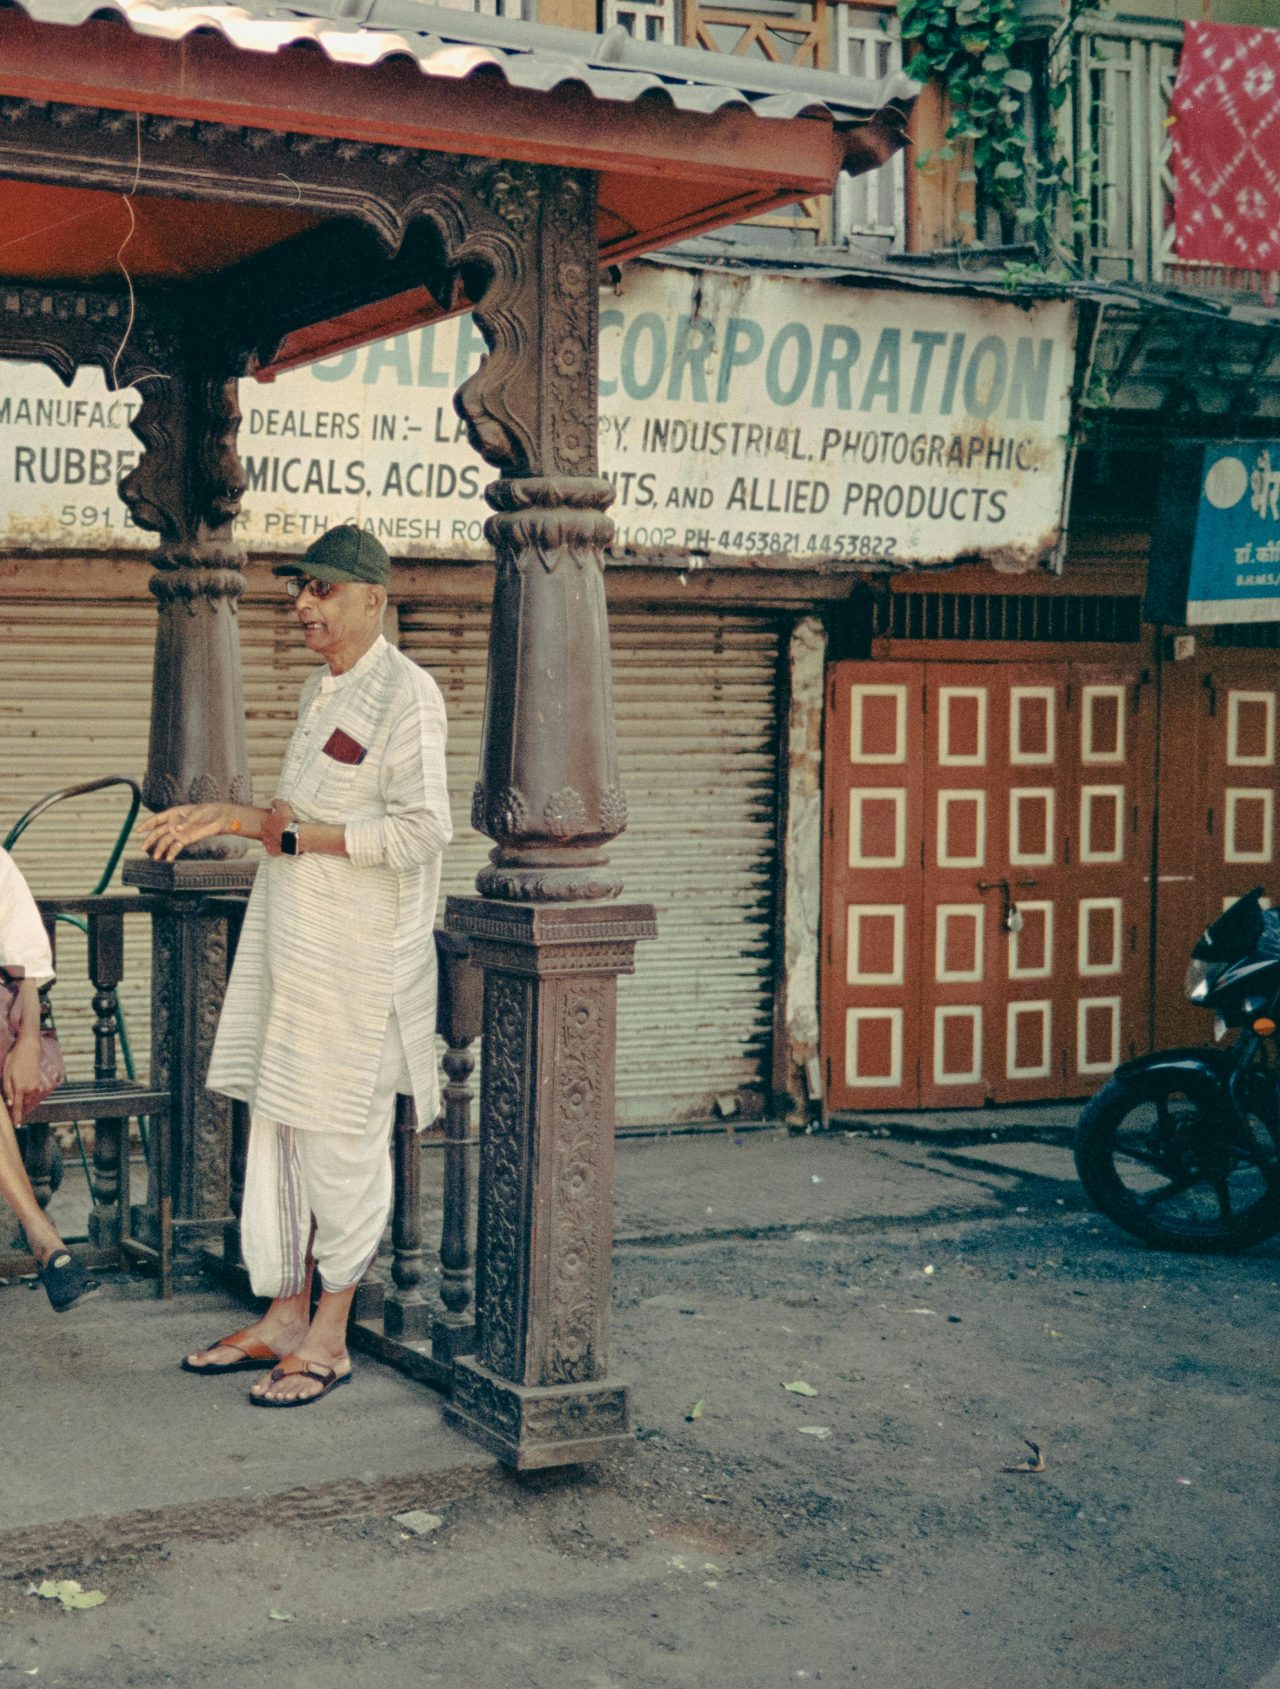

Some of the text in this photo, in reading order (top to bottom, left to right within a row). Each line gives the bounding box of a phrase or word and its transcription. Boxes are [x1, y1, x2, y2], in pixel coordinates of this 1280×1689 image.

[599, 309, 1054, 421] CORPORATION
[249, 409, 360, 440] DEALERS
[234, 456, 372, 497] MICALS,
[665, 487, 714, 509] AND
[726, 477, 829, 513] ALLIED
[843, 483, 1008, 523] PRODUCTS
[265, 513, 328, 535] PETH
[344, 517, 440, 539] ANESH
